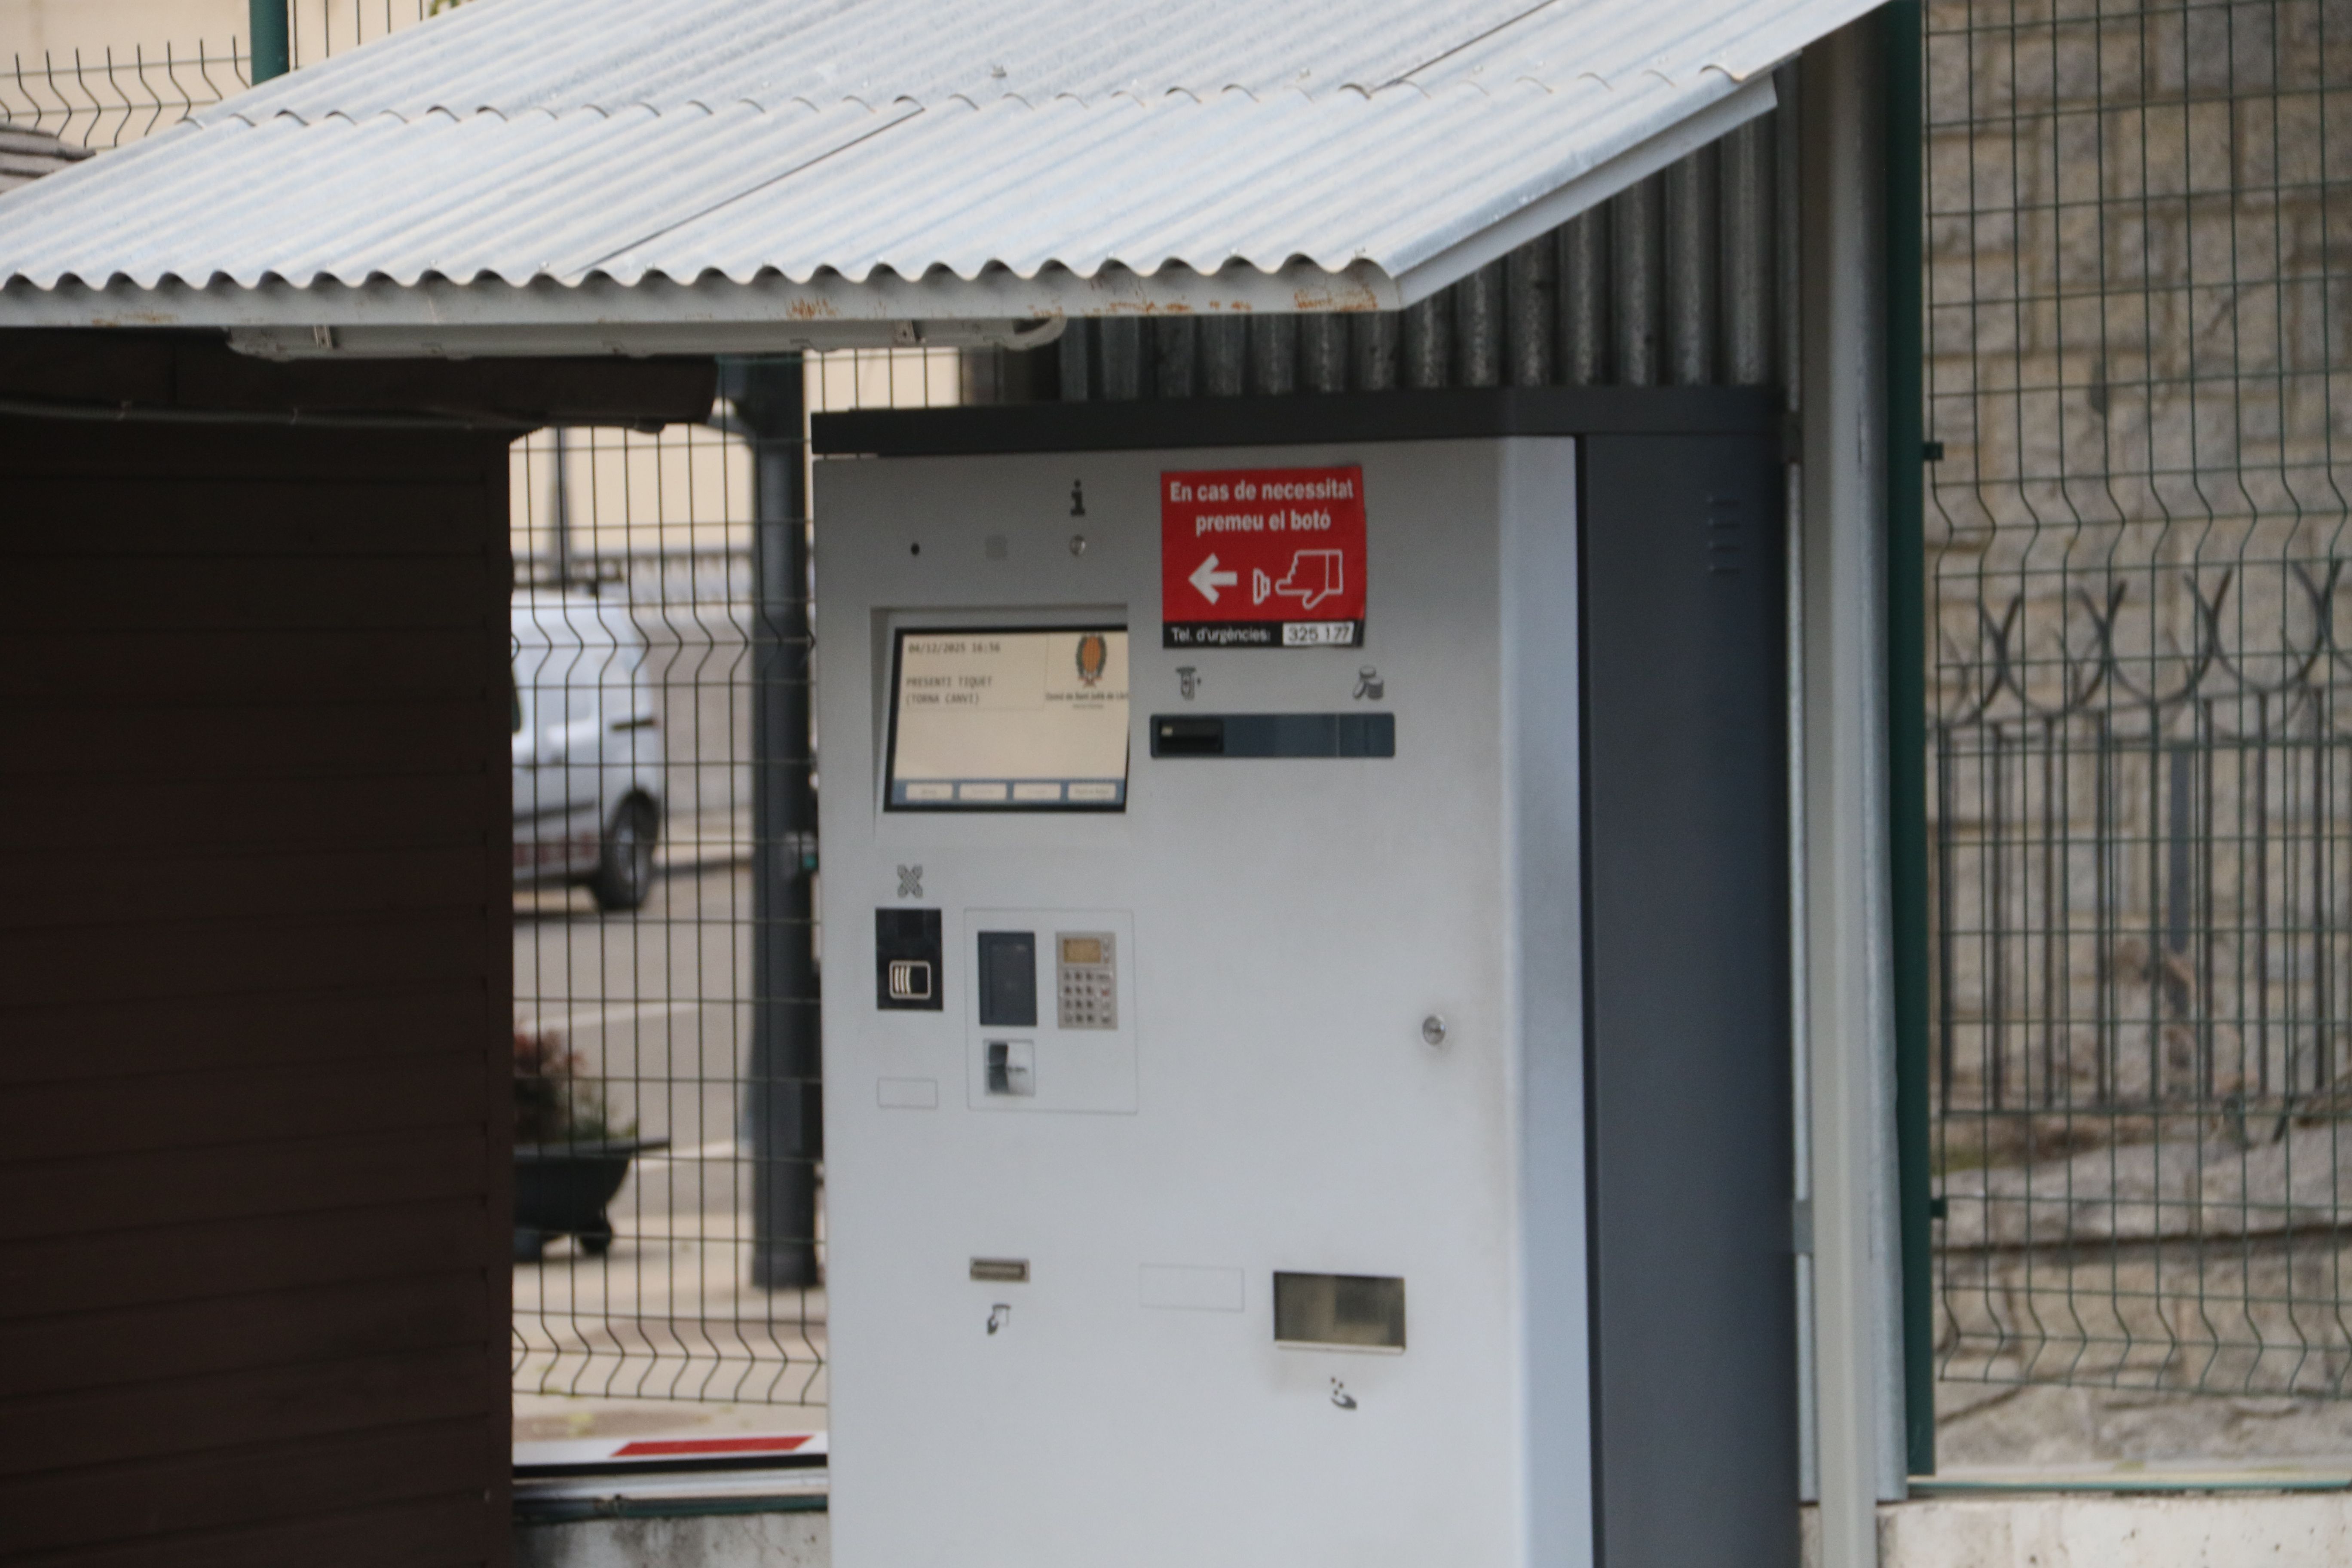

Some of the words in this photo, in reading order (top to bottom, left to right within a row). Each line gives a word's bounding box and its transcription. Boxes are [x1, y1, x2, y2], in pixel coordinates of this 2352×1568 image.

[1170, 481, 1192, 502] En
[1197, 484, 1229, 502] cas
[1234, 480, 1257, 501] de
[1262, 478, 1354, 500] necessitat
[1196, 513, 1263, 537] premeu
[1269, 510, 1286, 531] el
[1290, 508, 1331, 531] botó
[1171, 627, 1192, 642] Tel.
[1196, 627, 1271, 645] d'urgències:
[1289, 627, 1318, 641] 325
[1326, 626, 1349, 640] 177
